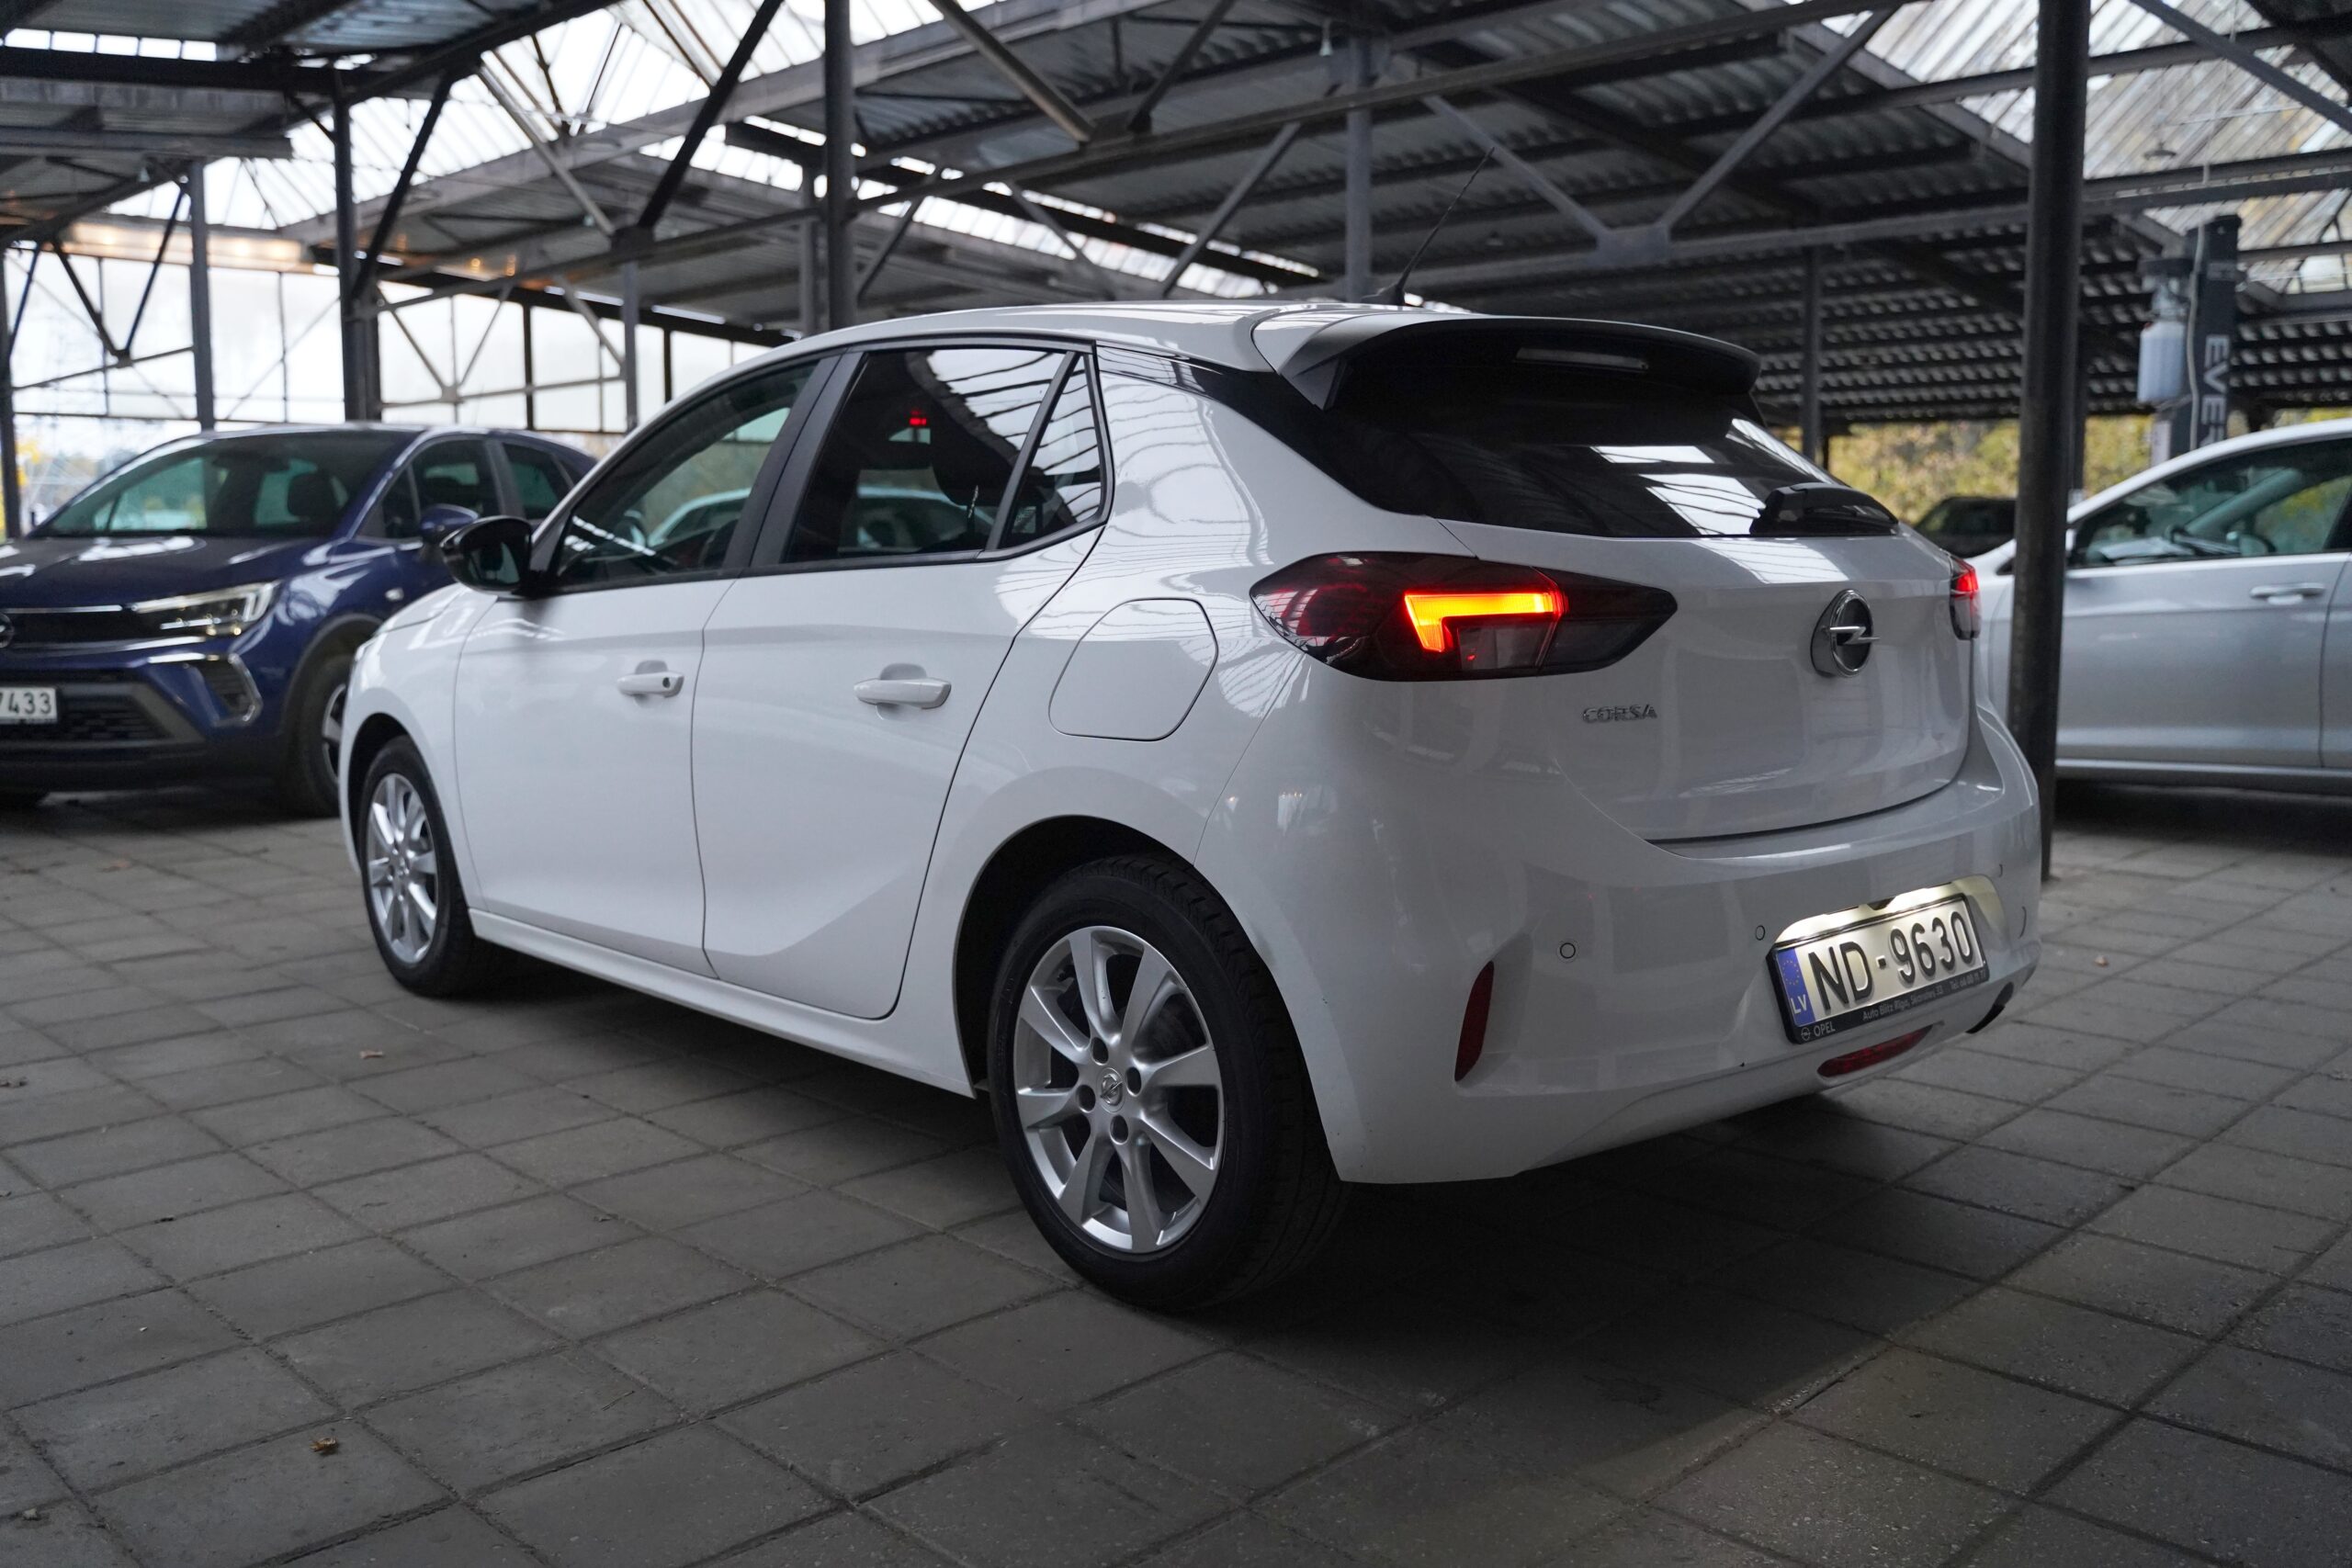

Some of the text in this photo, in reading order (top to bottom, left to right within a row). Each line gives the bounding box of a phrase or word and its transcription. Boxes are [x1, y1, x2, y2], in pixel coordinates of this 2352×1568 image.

[0, 692, 51, 715] 433
[1582, 704, 1658, 724] CORSA
[1791, 994, 1807, 1014] LV
[1814, 1021, 1836, 1037] OPEL
